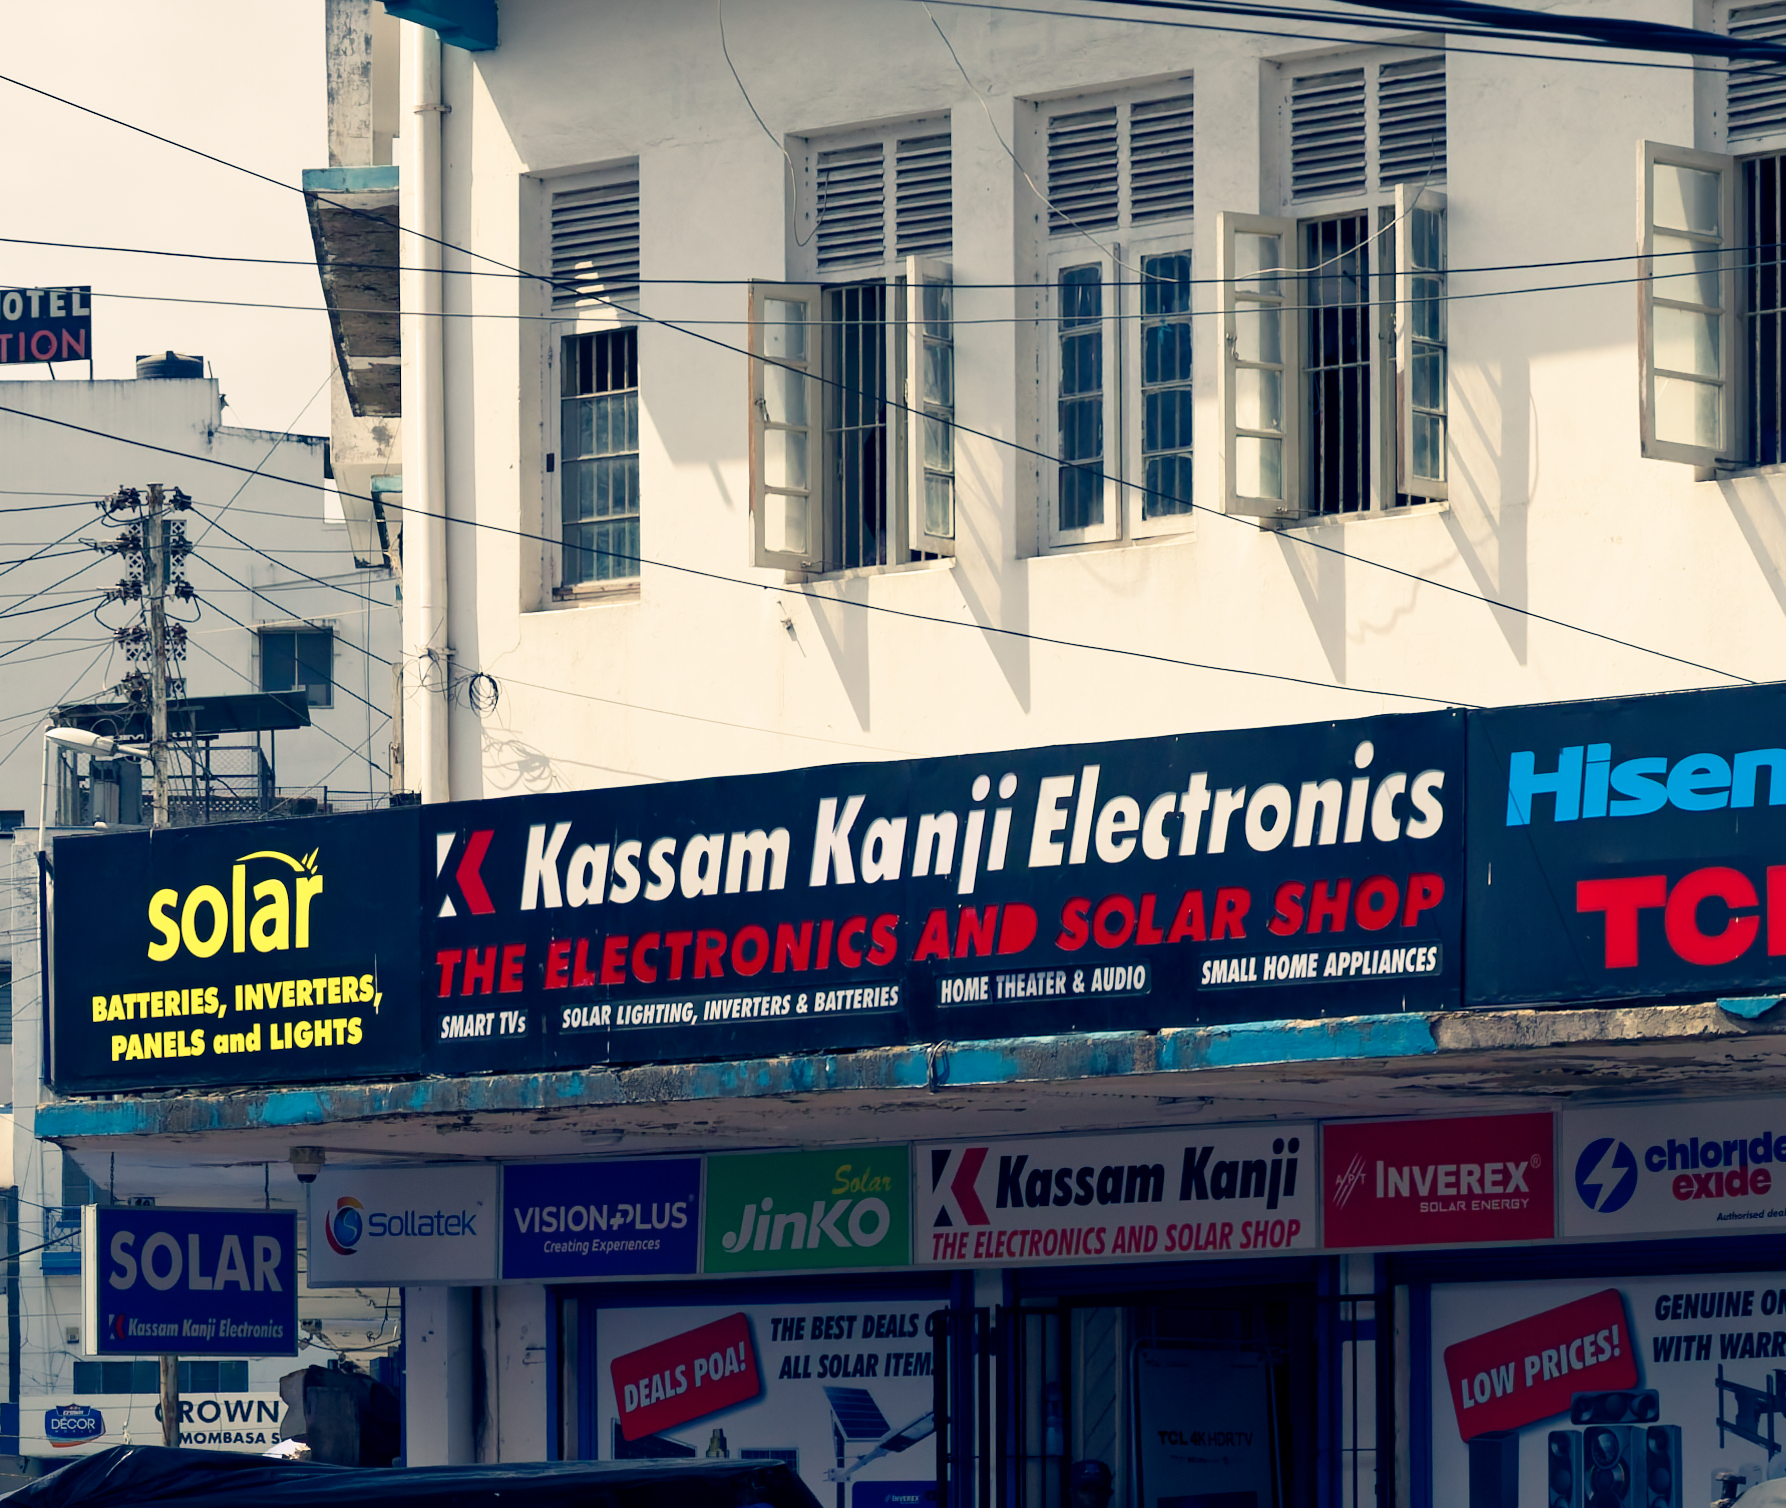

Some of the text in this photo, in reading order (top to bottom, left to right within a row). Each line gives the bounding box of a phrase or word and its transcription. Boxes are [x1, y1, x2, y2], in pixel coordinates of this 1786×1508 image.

[521, 741, 1445, 912] Kassam Kanji Electronics
[147, 858, 324, 962] solar
[436, 871, 1444, 999] THE ELECTRONICS AND SOLAR SHOP
[92, 974, 382, 1023] BATTERIES, INVERTERS,
[440, 946, 1438, 1040] SMART TVs SOLAR LIGHTING, INVERTERS & BATTERIES HOME THEATER & AUDIO SMALL HOME APPLIANCES
[111, 1016, 362, 1062] PANELS and LIGHTS
[832, 1164, 892, 1195] Solar
[996, 1137, 1300, 1210] Kassam Kanji
[1672, 1165, 1772, 1201] exide
[1420, 1197, 1530, 1214] SOLAR ENERGY
[1717, 1209, 1765, 1221] Authorised
[369, 1210, 477, 1237] Sollatek
[932, 1218, 1301, 1260] THE ELECTRONICS AND SOLAR SHOP
[109, 1231, 283, 1292] SOLAR
[544, 1237, 661, 1256] Creating Experiences
[1655, 1290, 1753, 1321] GENUINE
[128, 1317, 284, 1341] Kassam Kanji Electronics
[771, 1313, 920, 1341] THE BEST DEALS
[1653, 1335, 1714, 1363] WITH
[624, 1341, 746, 1413] DEALS POA!
[779, 1355, 811, 1379] ALL
[817, 1353, 877, 1378] SOLAR
[1462, 1325, 1620, 1411] LOW PRICES!
[179, 1432, 263, 1444] MOMBASA
[1158, 1431, 1206, 1445] TCL 4K
